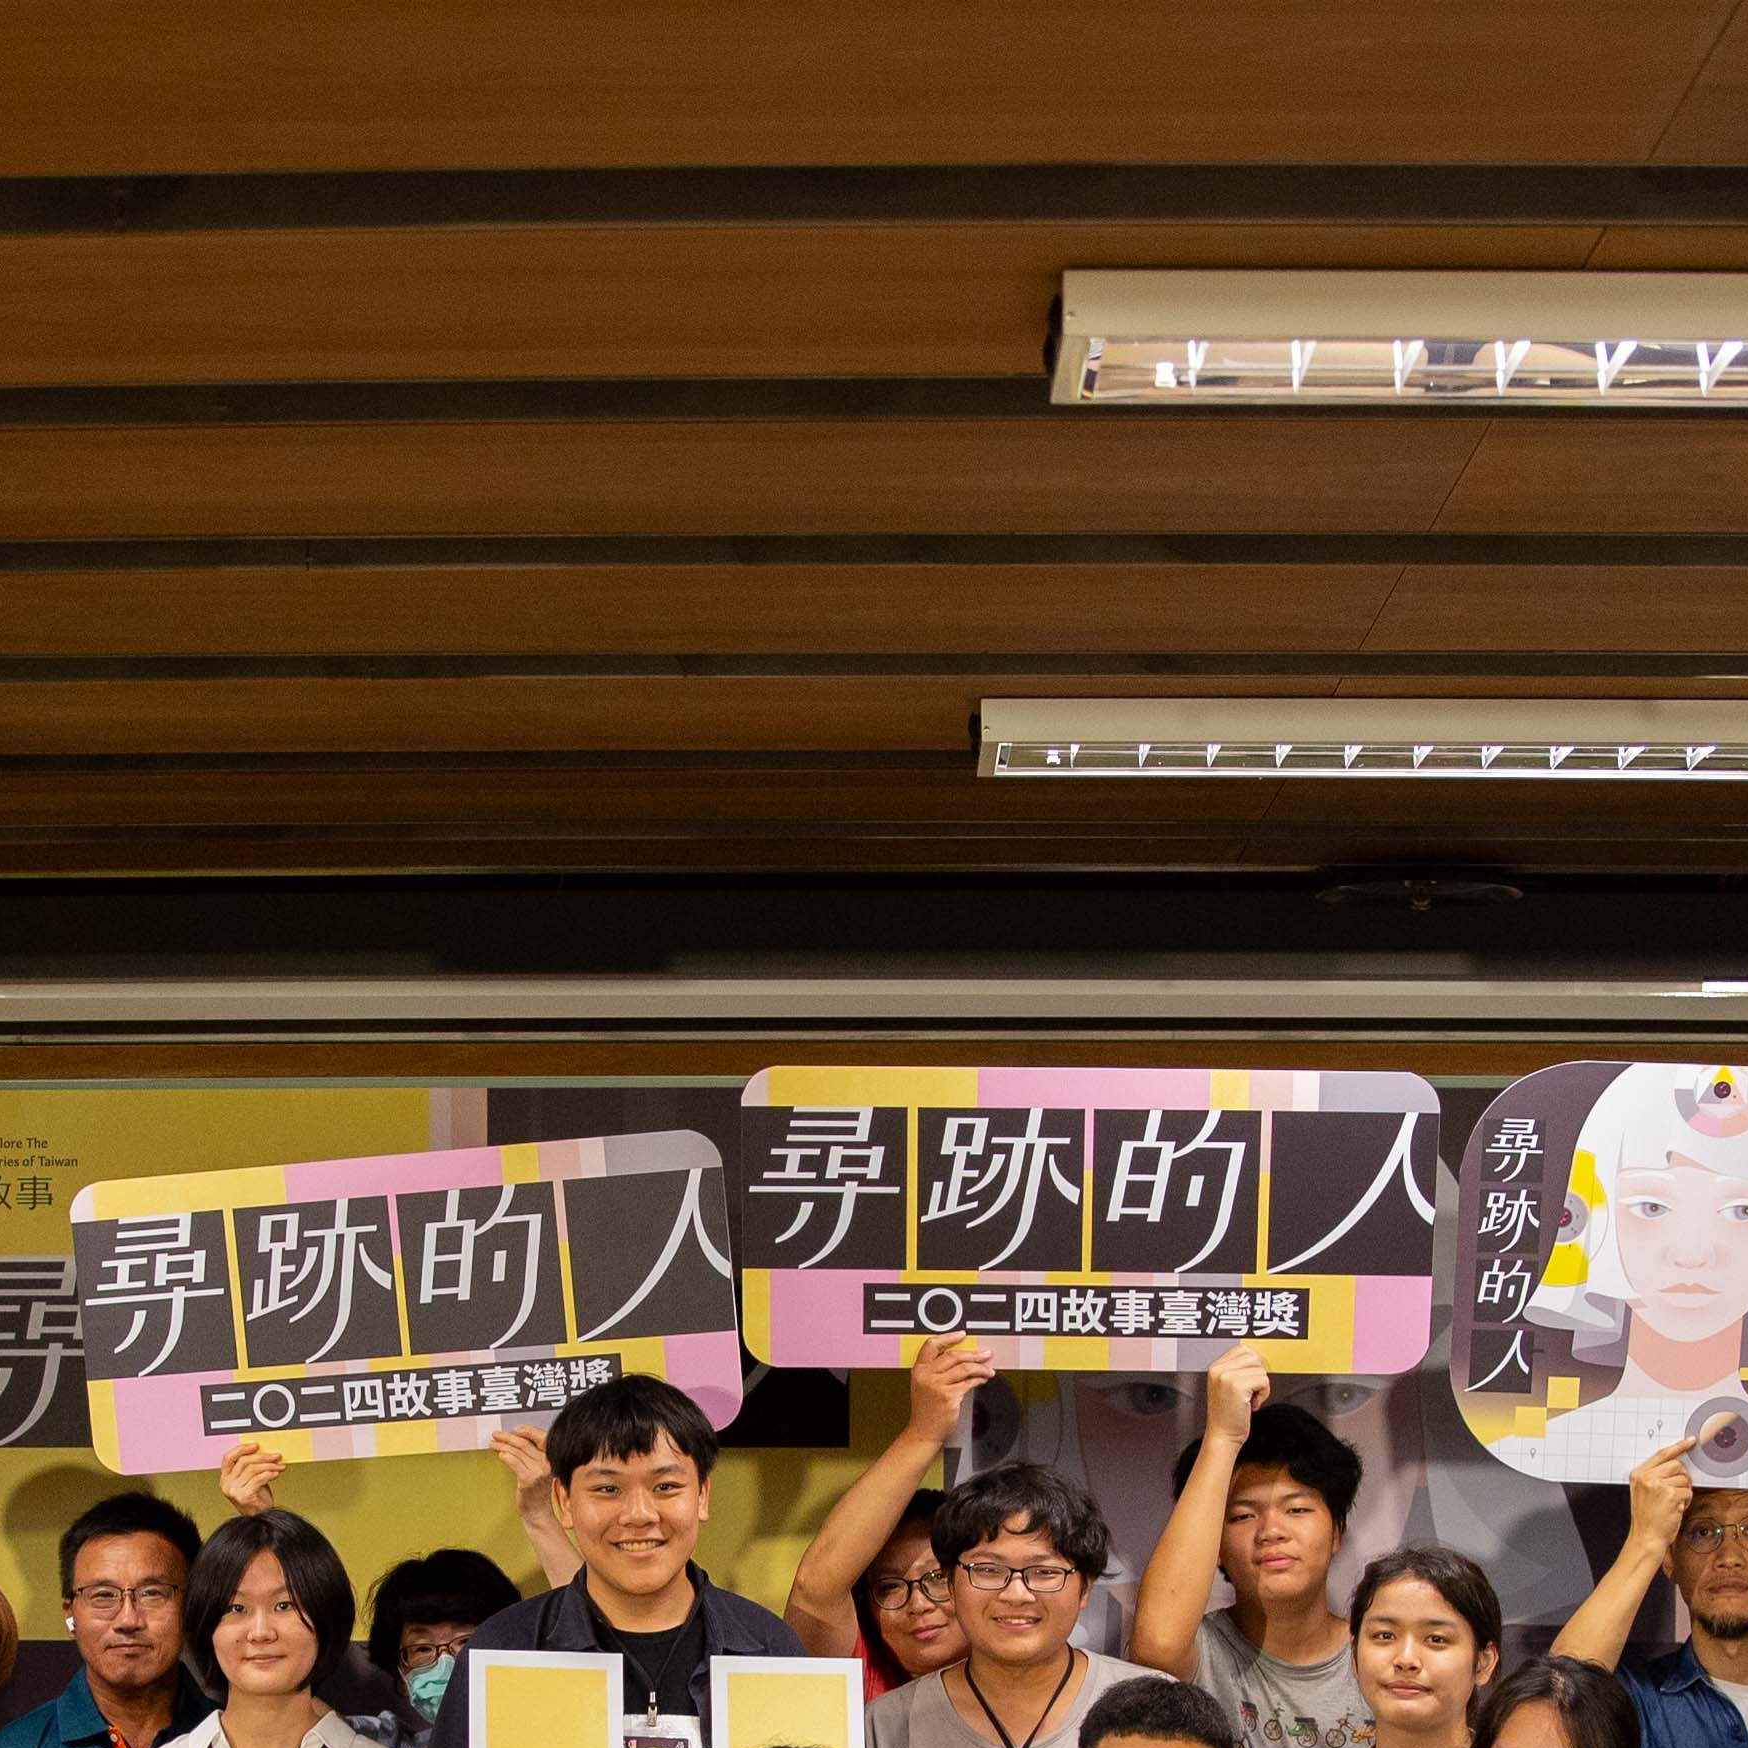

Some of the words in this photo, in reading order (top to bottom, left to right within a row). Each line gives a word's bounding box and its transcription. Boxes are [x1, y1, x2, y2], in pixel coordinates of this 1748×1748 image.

[22, 1155, 35, 1168] of
[37, 1155, 79, 1168] Taiwan
[28, 1138, 48, 1149] The
[749, 1106, 1435, 1275] 尋跡的人
[86, 1168, 731, 1377] 尋跡的人
[1464, 1118, 1543, 1393] 尋跡的人
